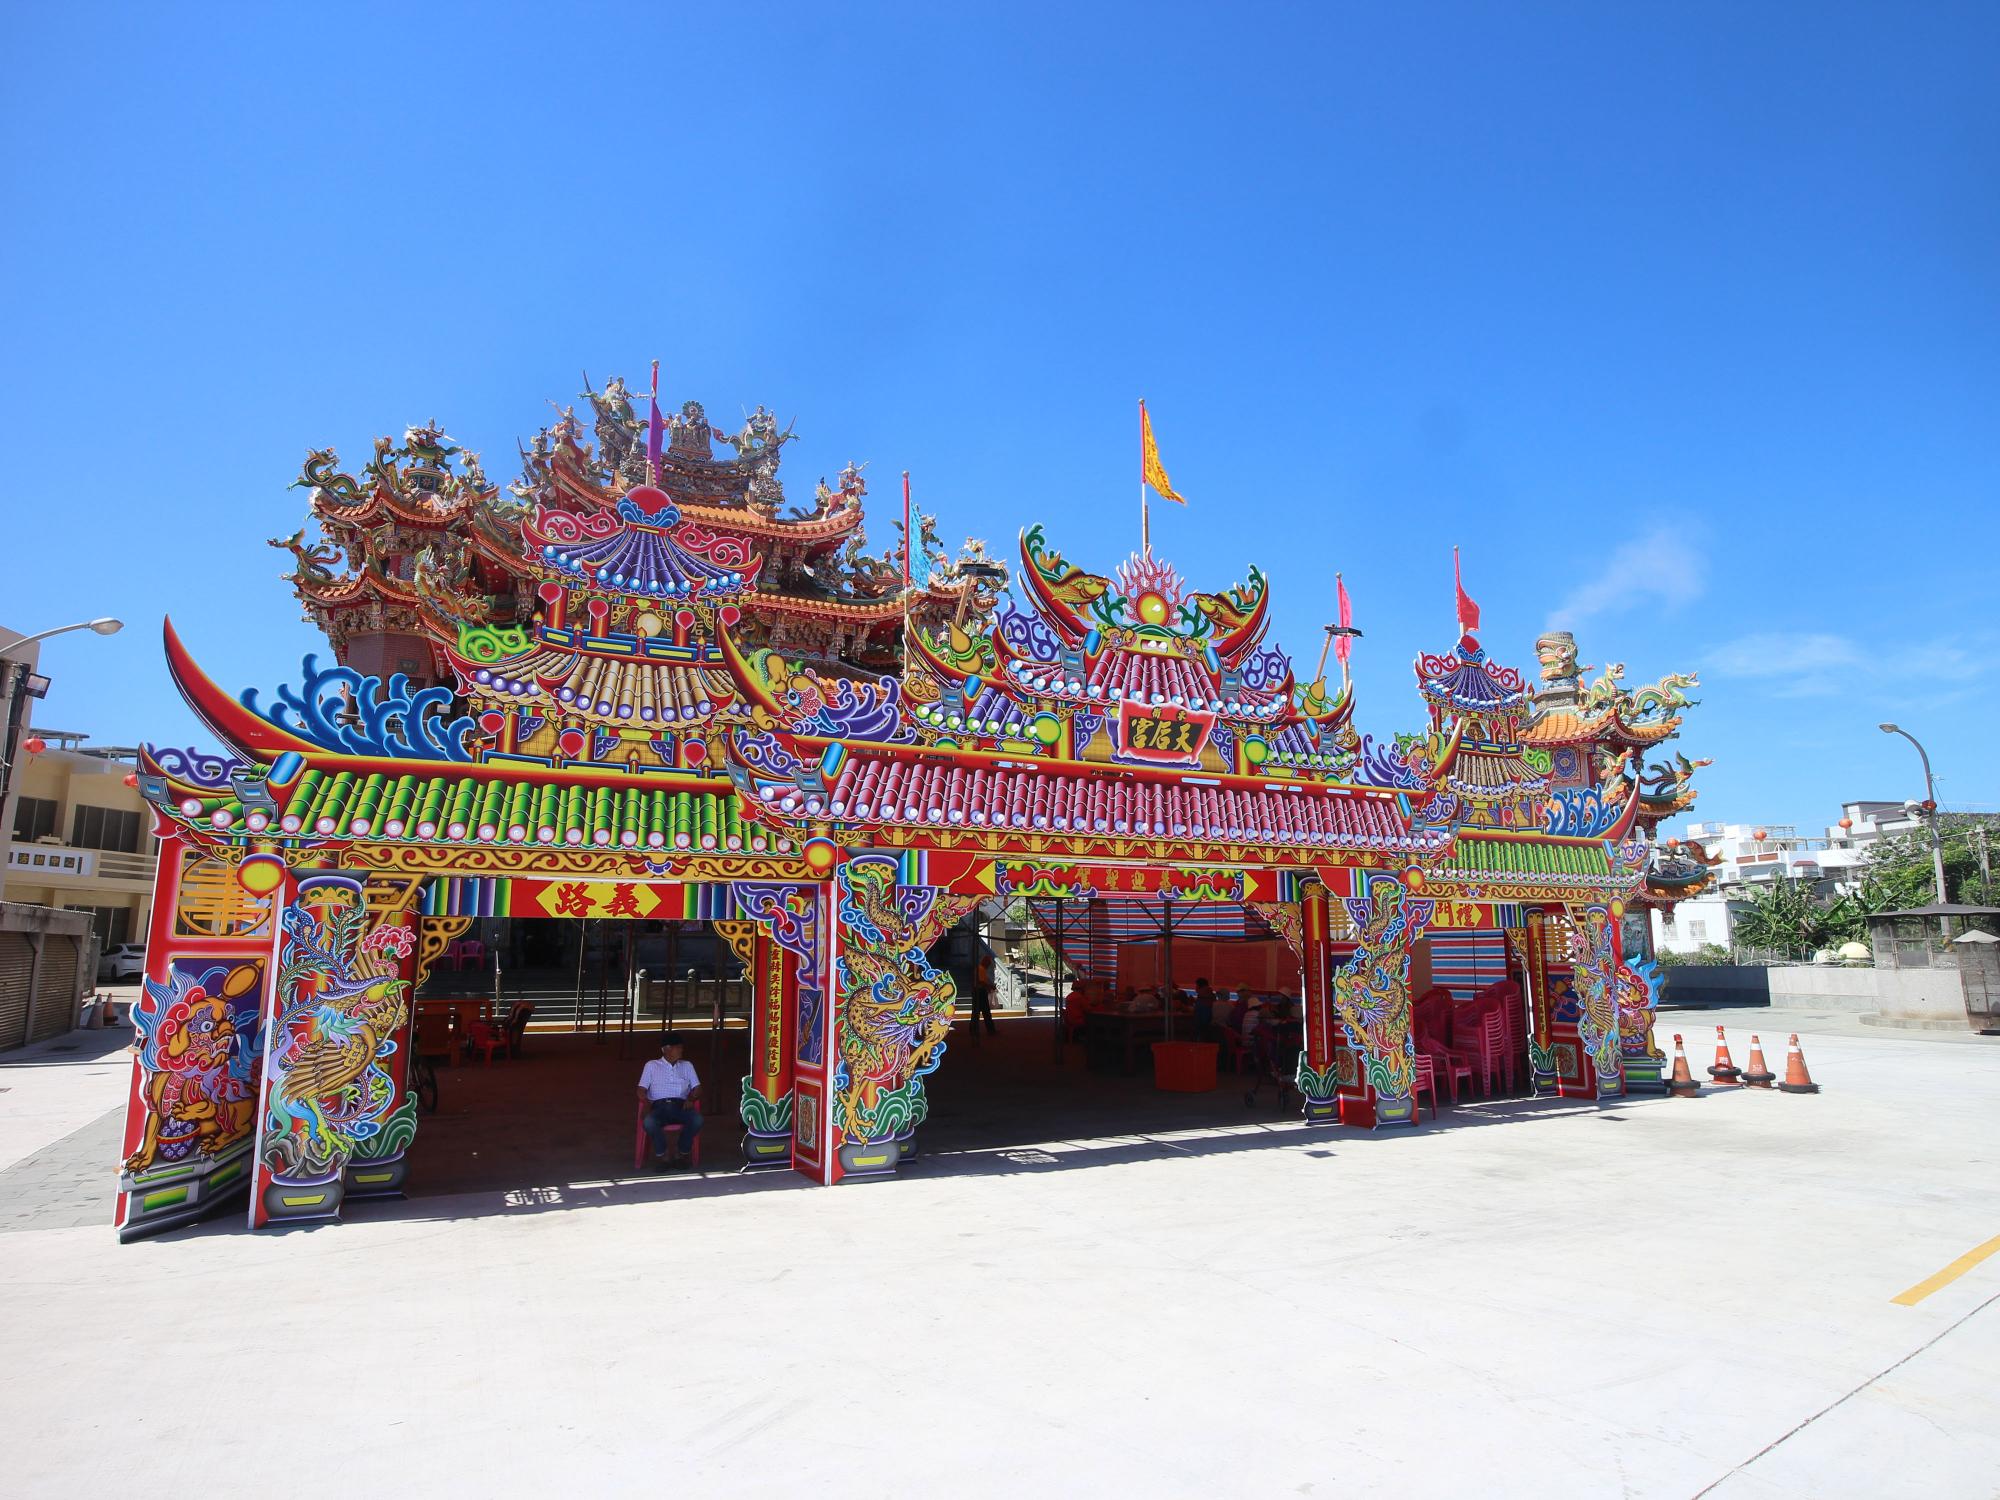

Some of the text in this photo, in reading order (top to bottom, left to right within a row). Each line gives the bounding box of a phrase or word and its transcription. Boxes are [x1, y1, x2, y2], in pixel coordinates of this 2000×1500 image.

[1132, 718, 1193, 753] 天后宮
[555, 881, 644, 918] 義路
[1434, 902, 1477, 927] 禮門
